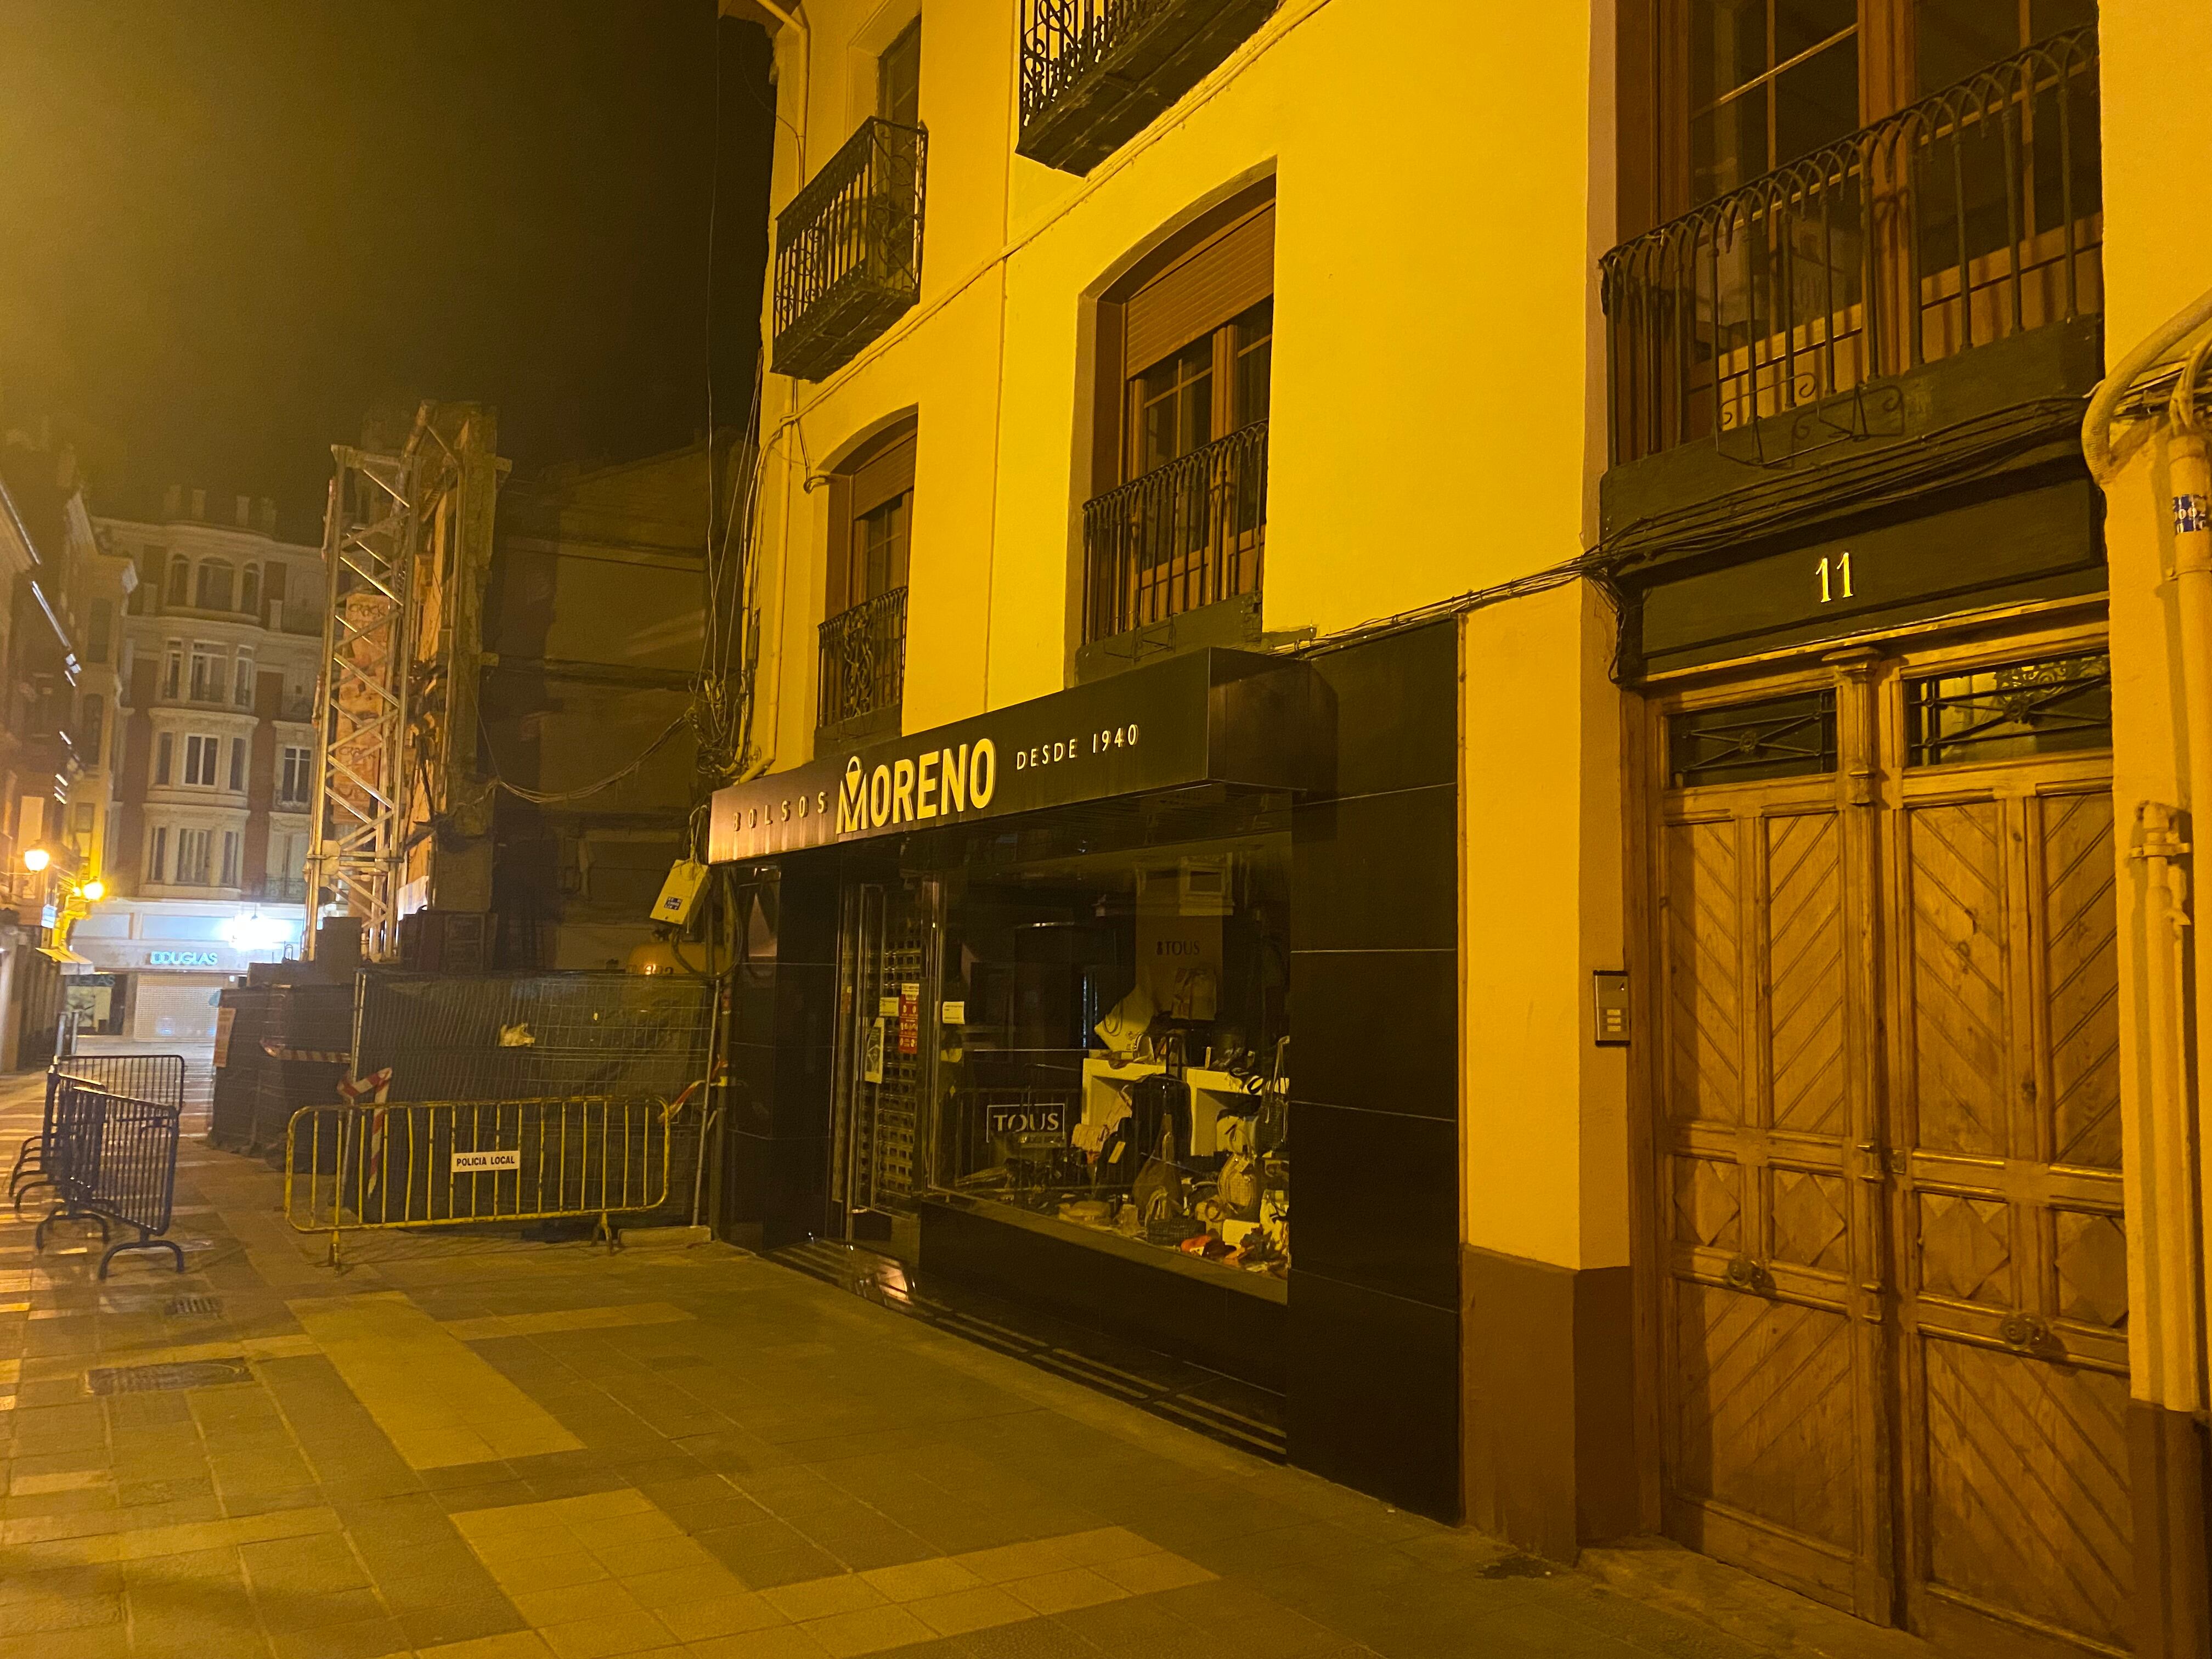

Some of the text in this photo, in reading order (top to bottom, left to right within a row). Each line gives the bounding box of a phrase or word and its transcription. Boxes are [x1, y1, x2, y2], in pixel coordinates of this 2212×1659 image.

[1815, 552, 1853, 602] 11
[733, 724, 1138, 834] BOLSOS MORENO DESDE 1940
[1165, 940, 1200, 955] TOUS
[993, 1113, 1059, 1133] TOUS
[456, 1155, 515, 1167] POLICIA LOCAL
